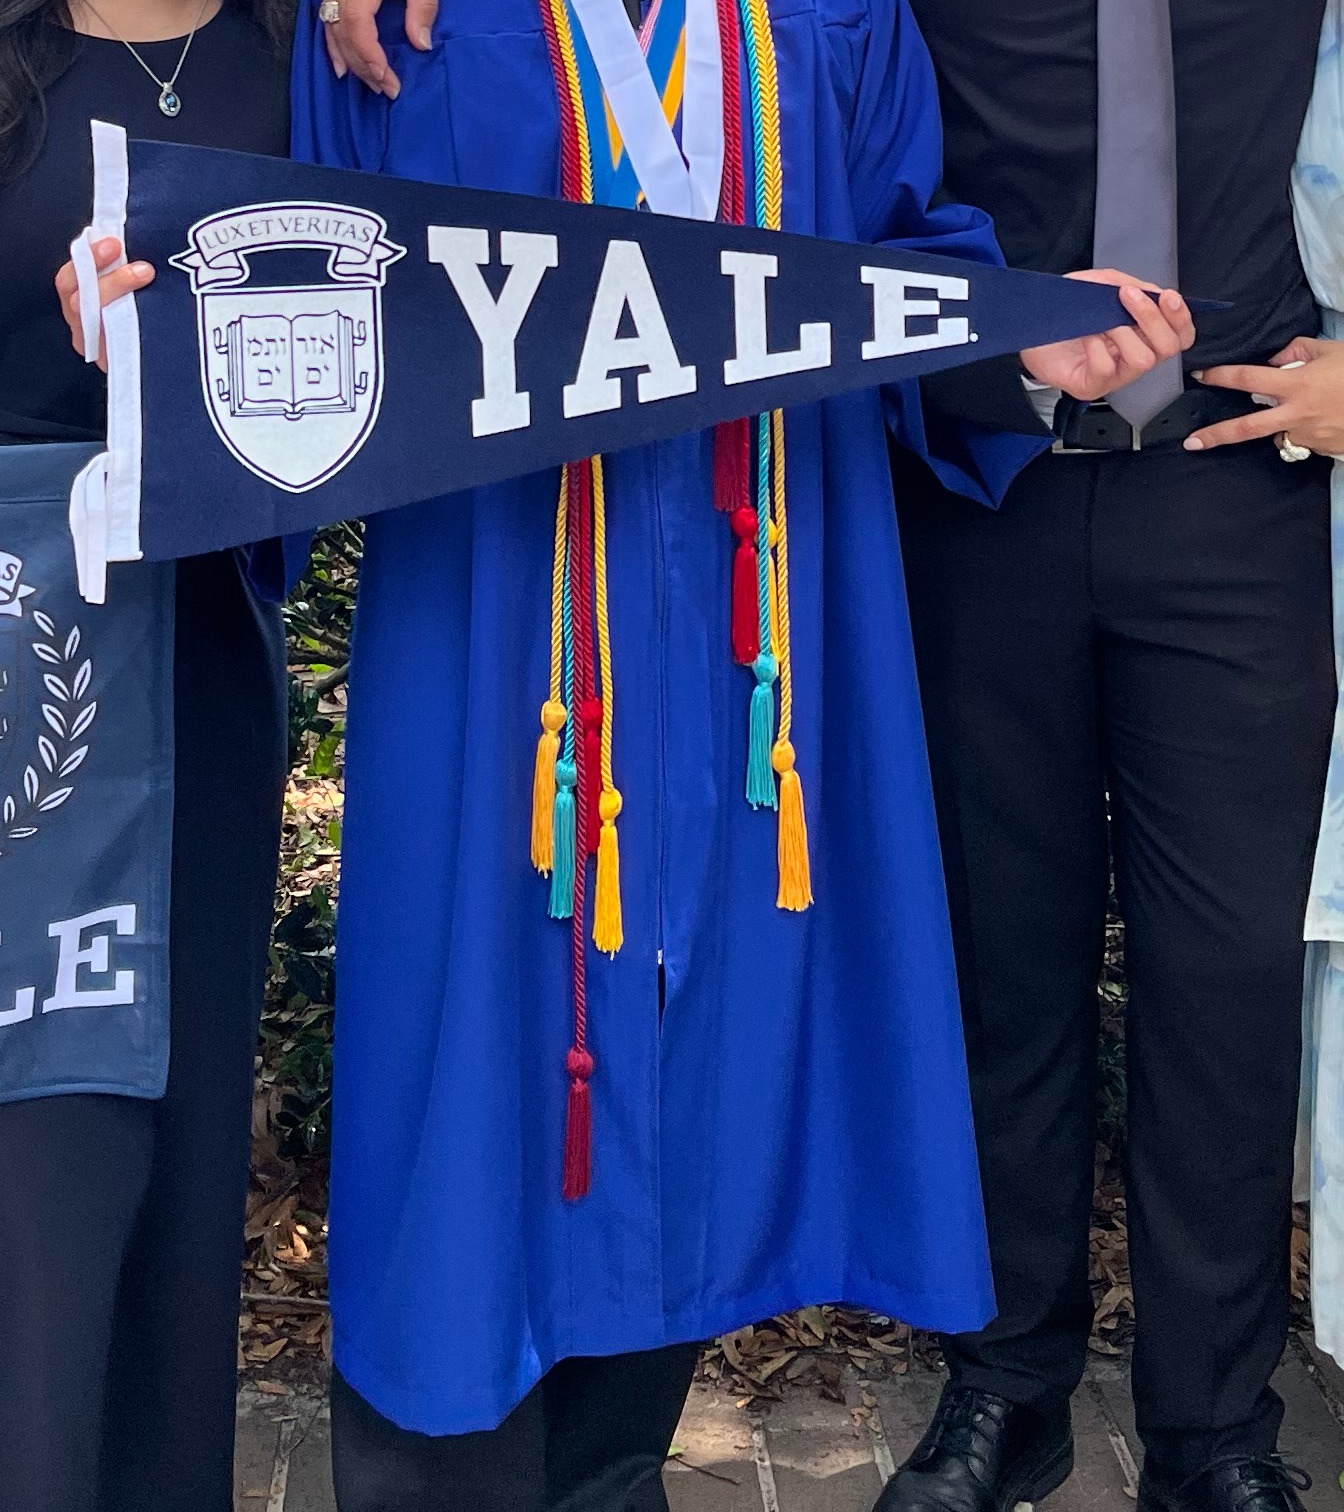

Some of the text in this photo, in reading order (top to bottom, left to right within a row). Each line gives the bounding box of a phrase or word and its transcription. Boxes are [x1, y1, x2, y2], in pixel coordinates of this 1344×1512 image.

[202, 216, 373, 250] LUX ET VERITAS
